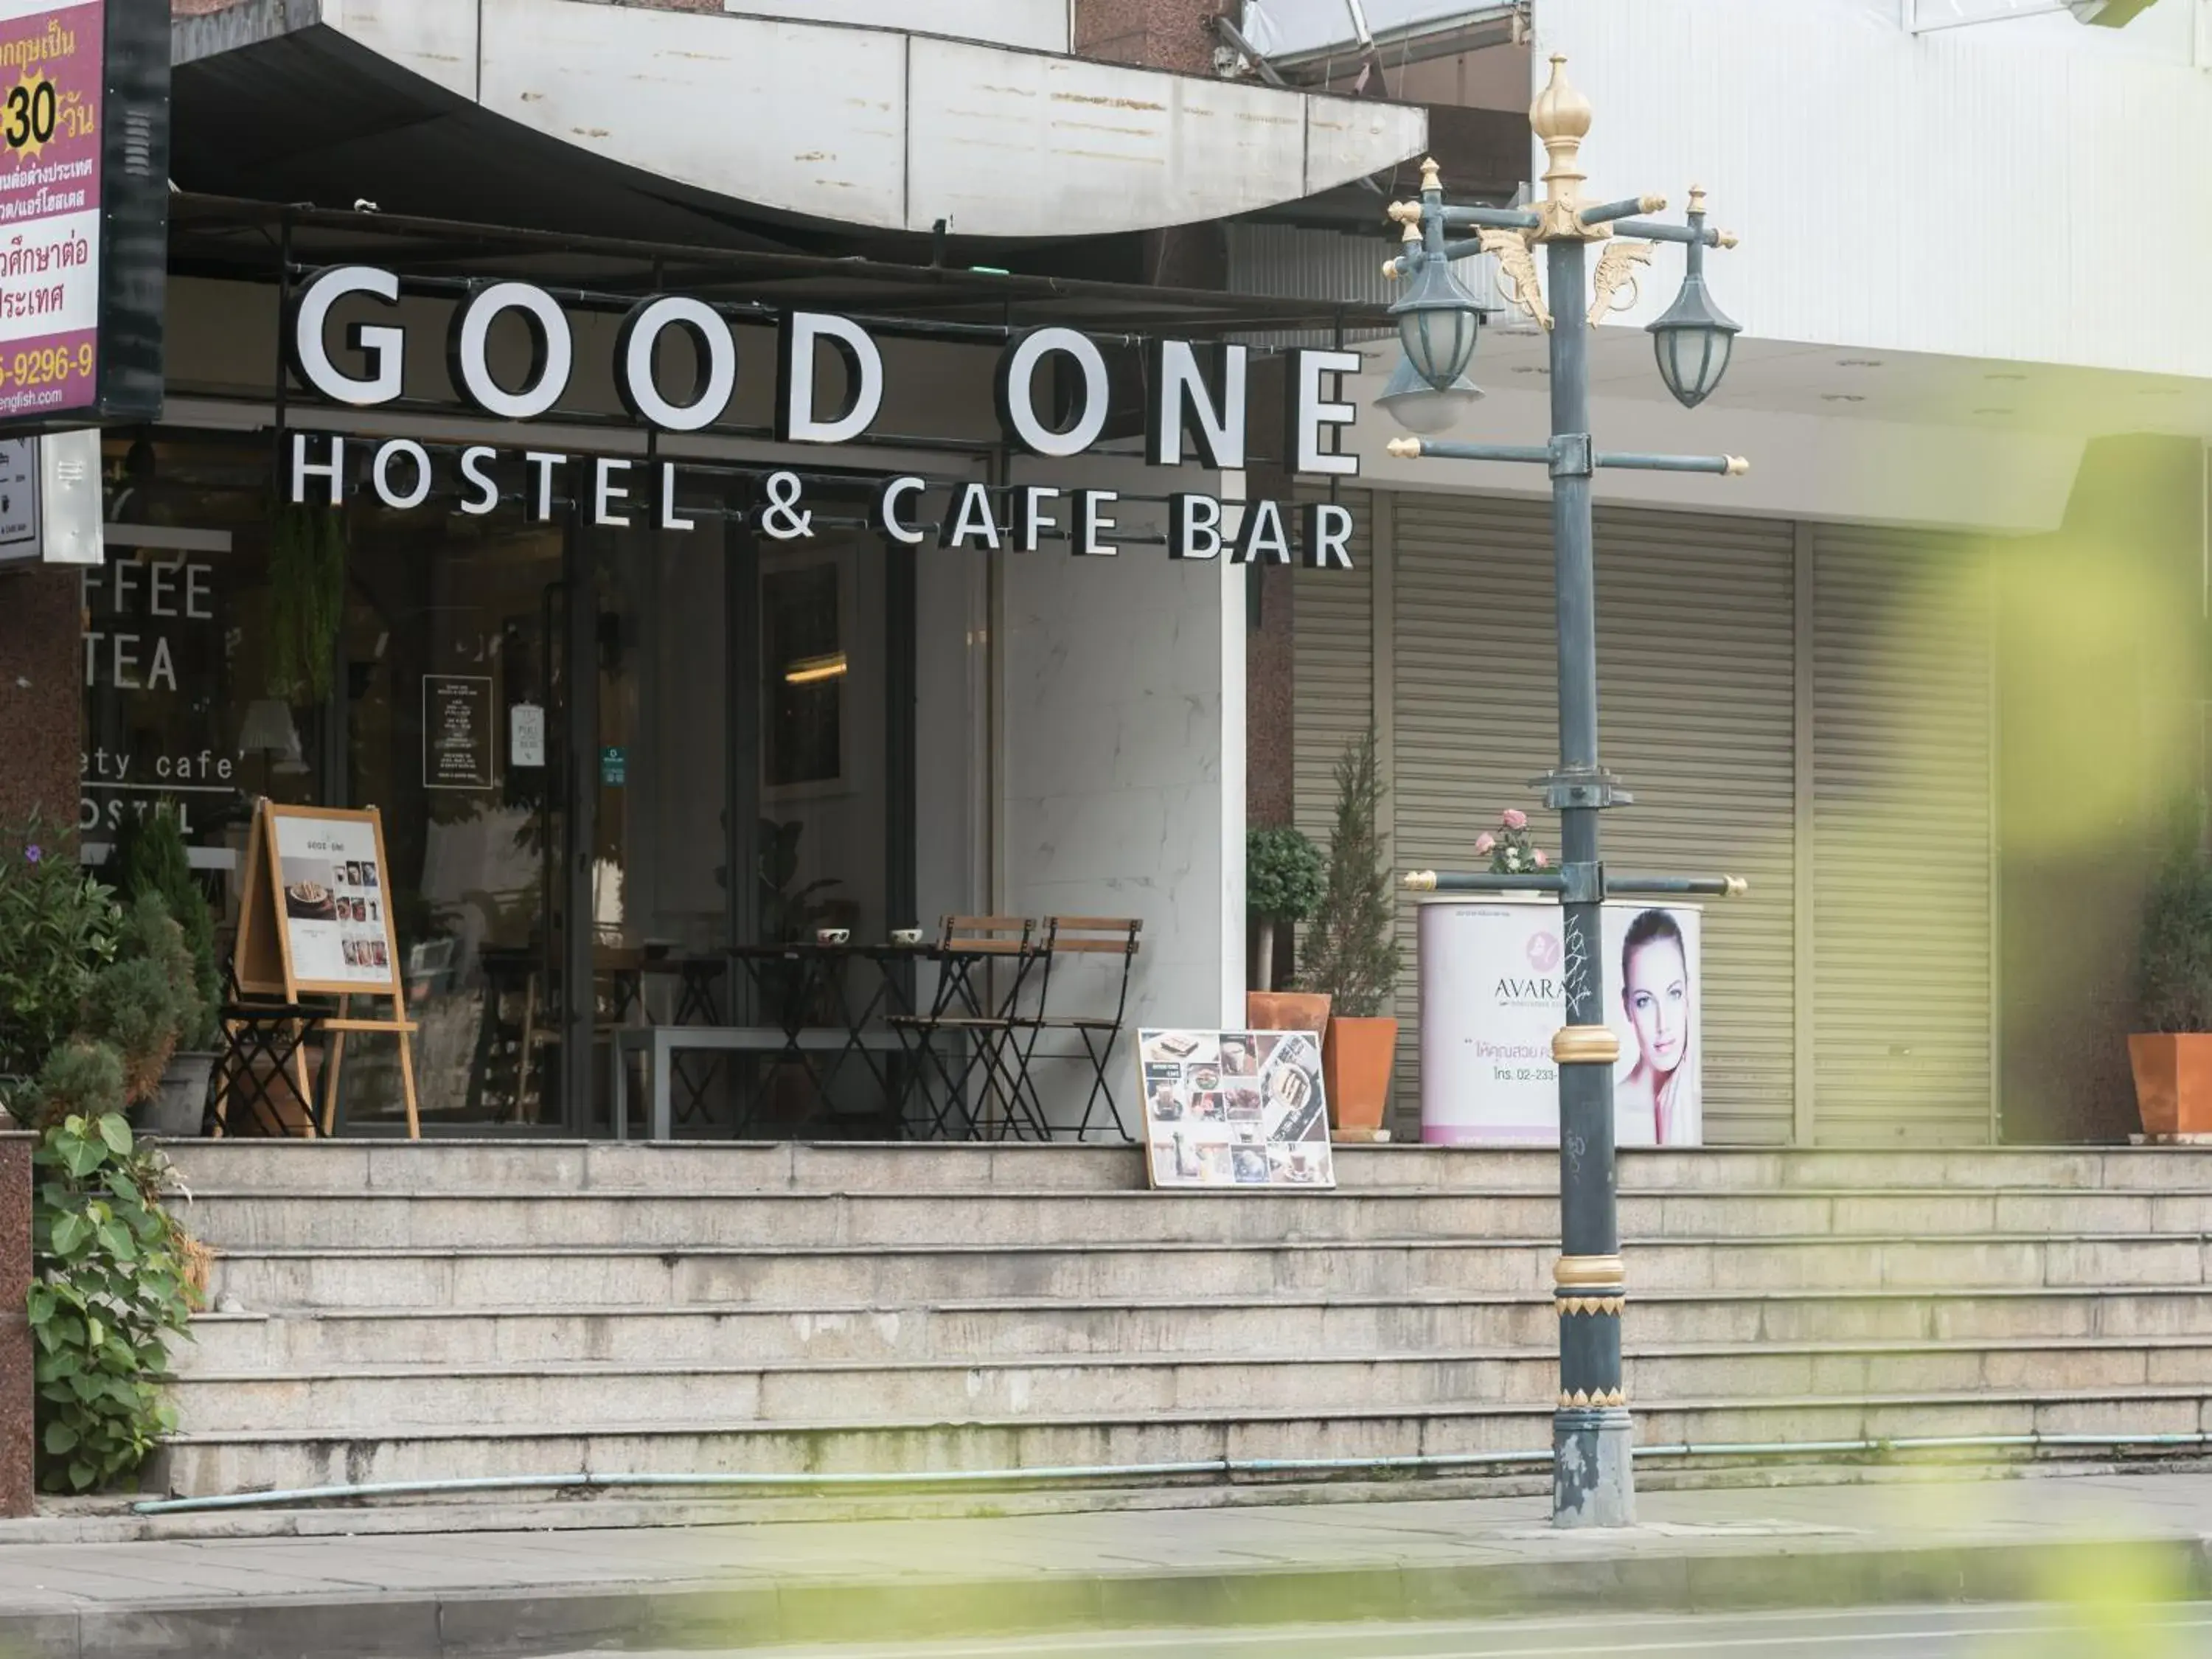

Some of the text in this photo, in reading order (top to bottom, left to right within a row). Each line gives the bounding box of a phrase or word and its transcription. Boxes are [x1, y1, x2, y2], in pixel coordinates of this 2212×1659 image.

[6, 81, 94, 147] 30 วัน
[0, 284, 64, 319] ระเทศ
[296, 266, 1360, 474] GOOD ONE
[293, 434, 1353, 568] HOSTEL & CAFE BAR
[81, 632, 177, 692] TEA
